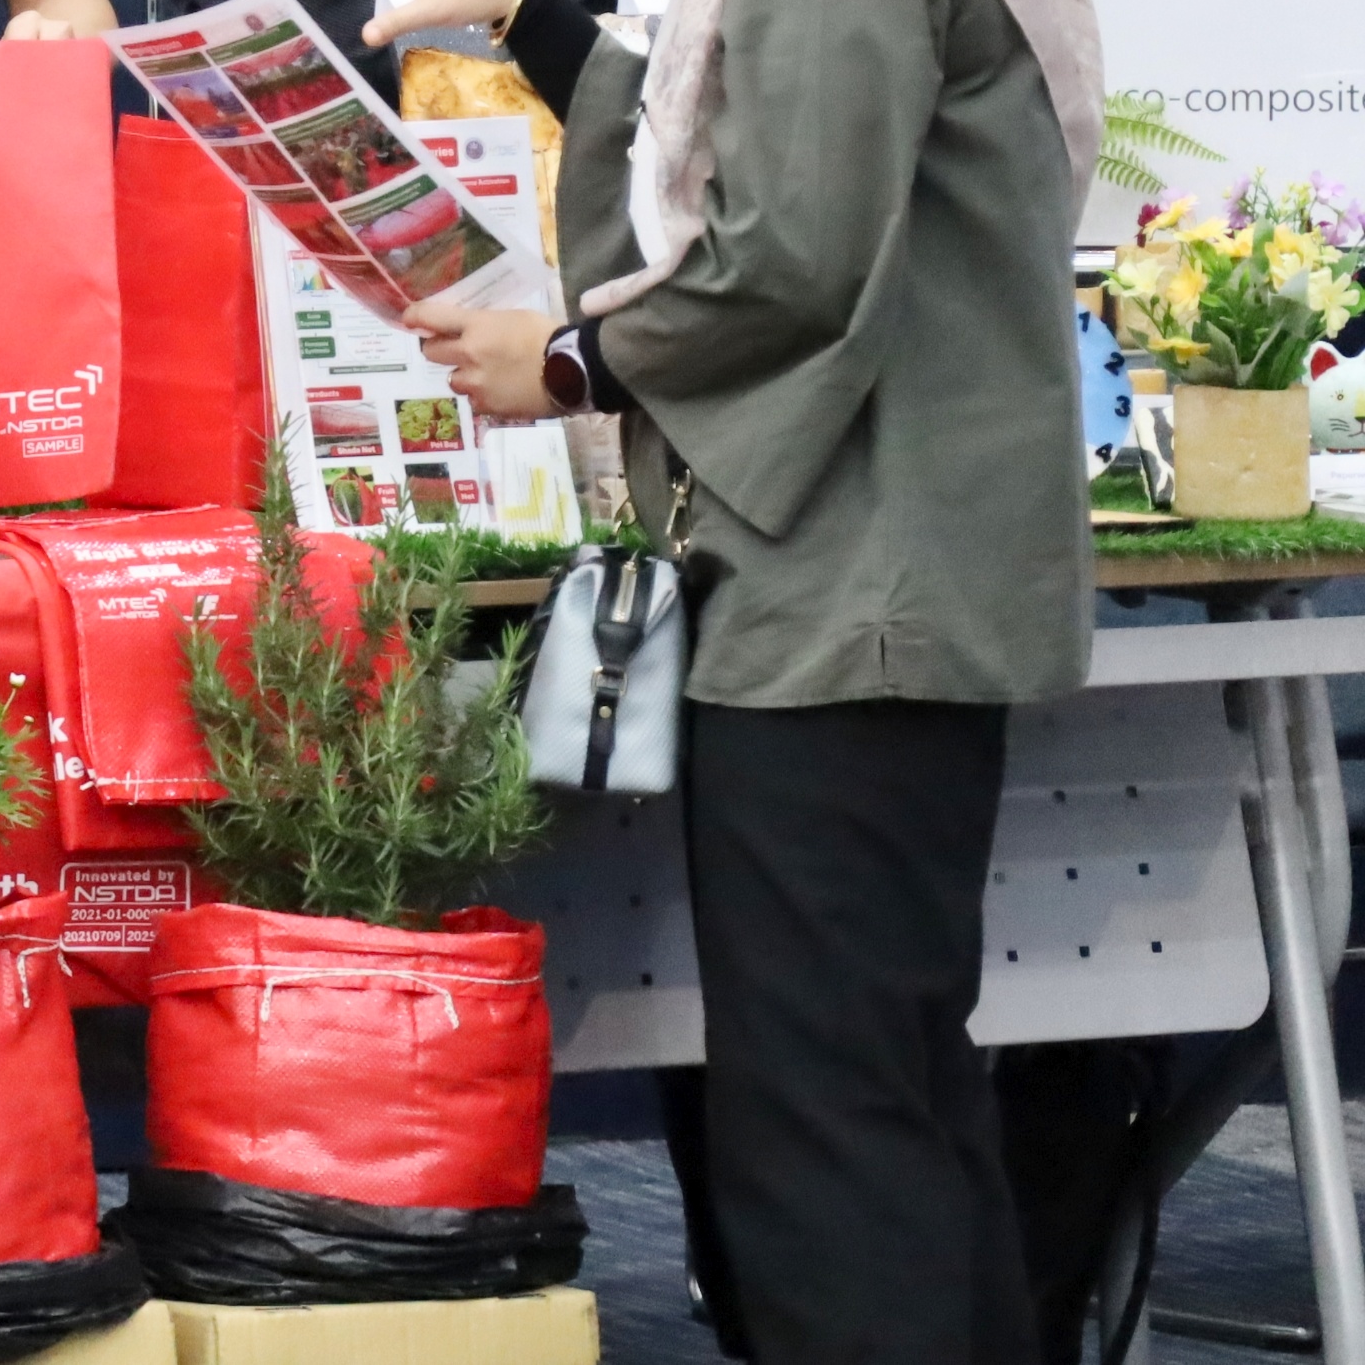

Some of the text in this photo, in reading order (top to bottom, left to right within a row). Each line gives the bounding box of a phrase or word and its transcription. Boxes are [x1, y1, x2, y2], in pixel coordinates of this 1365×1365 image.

[1078, 311, 1091, 333] 1
[1104, 352, 1125, 376] 2
[1114, 395, 1131, 417] 3
[7, 416, 82, 434] NSTDA
[26, 438, 80, 454] SAMPLE
[362, 445, 376, 454] Net
[444, 440, 459, 449] Bag
[1095, 442, 1113, 463] 4
[378, 487, 395, 495] Fruit
[381, 496, 397, 505] Bag
[74, 542, 218, 562] Magik Growth
[98, 596, 159, 610] MTEC
[120, 611, 159, 619] NSTDA
[75, 869, 175, 884] Innovated by
[74, 885, 176, 902] NSTDA
[71, 908, 172, 921] 2021-01-000
[64, 931, 121, 942] 20210709
